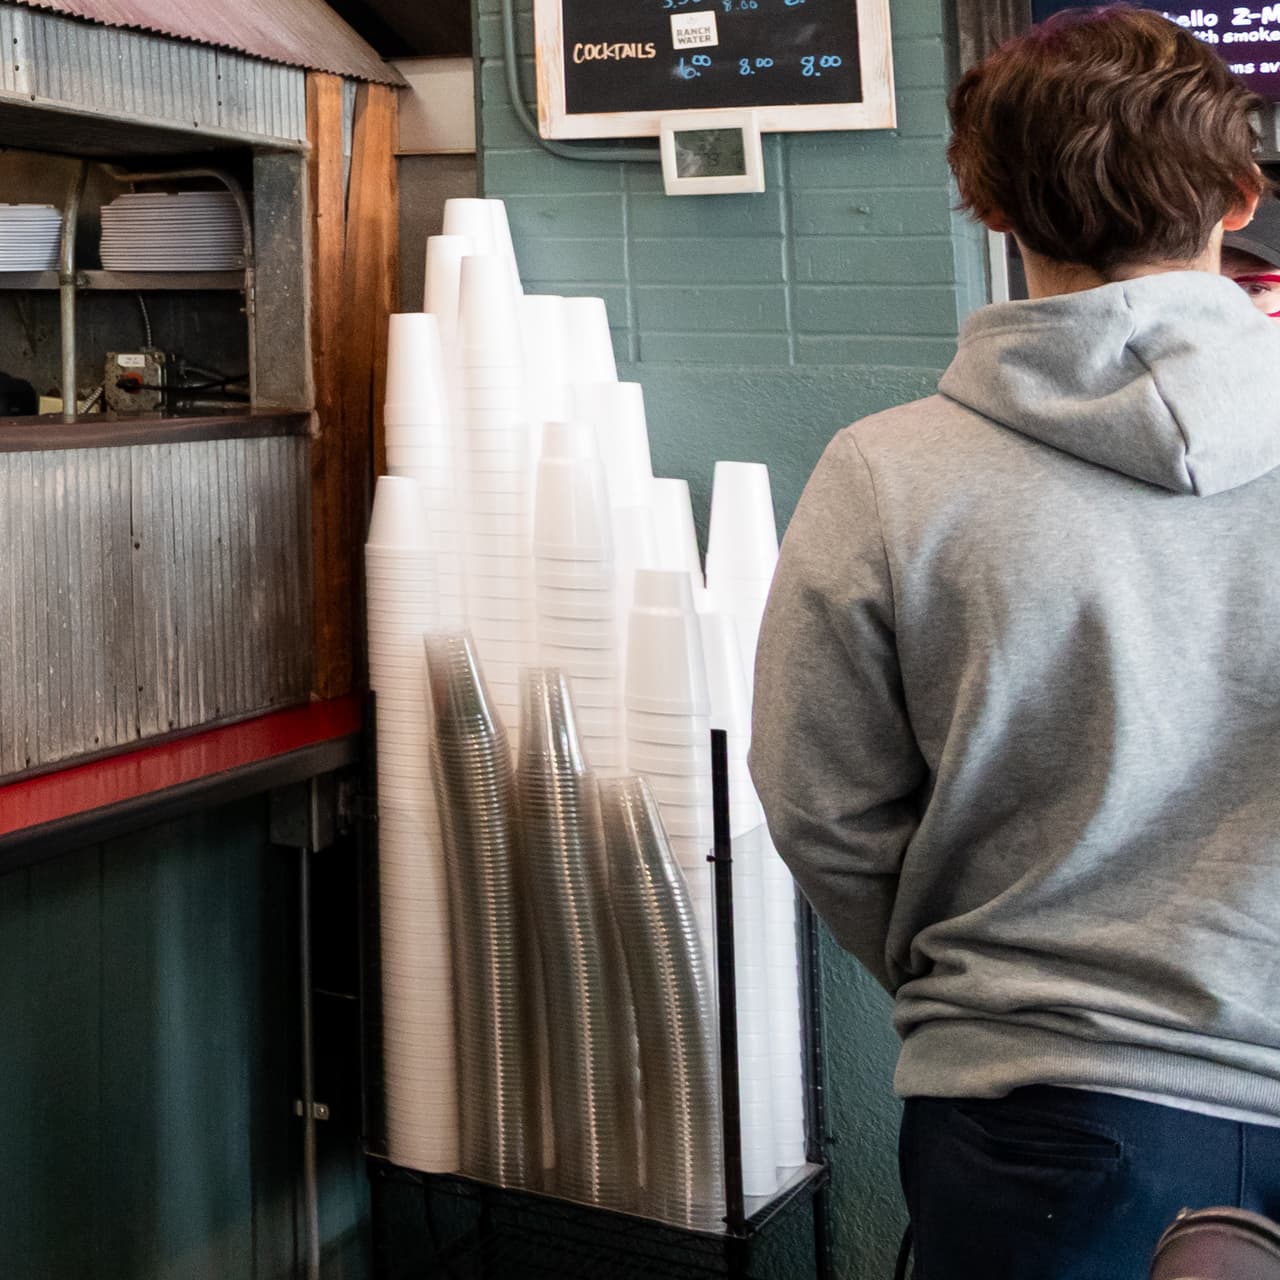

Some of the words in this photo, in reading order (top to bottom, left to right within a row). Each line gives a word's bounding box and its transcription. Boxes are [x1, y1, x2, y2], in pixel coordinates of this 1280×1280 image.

[676, 26, 711, 36] RANCH
[677, 35, 712, 45] WATER
[572, 42, 656, 64] COCKTAILS
